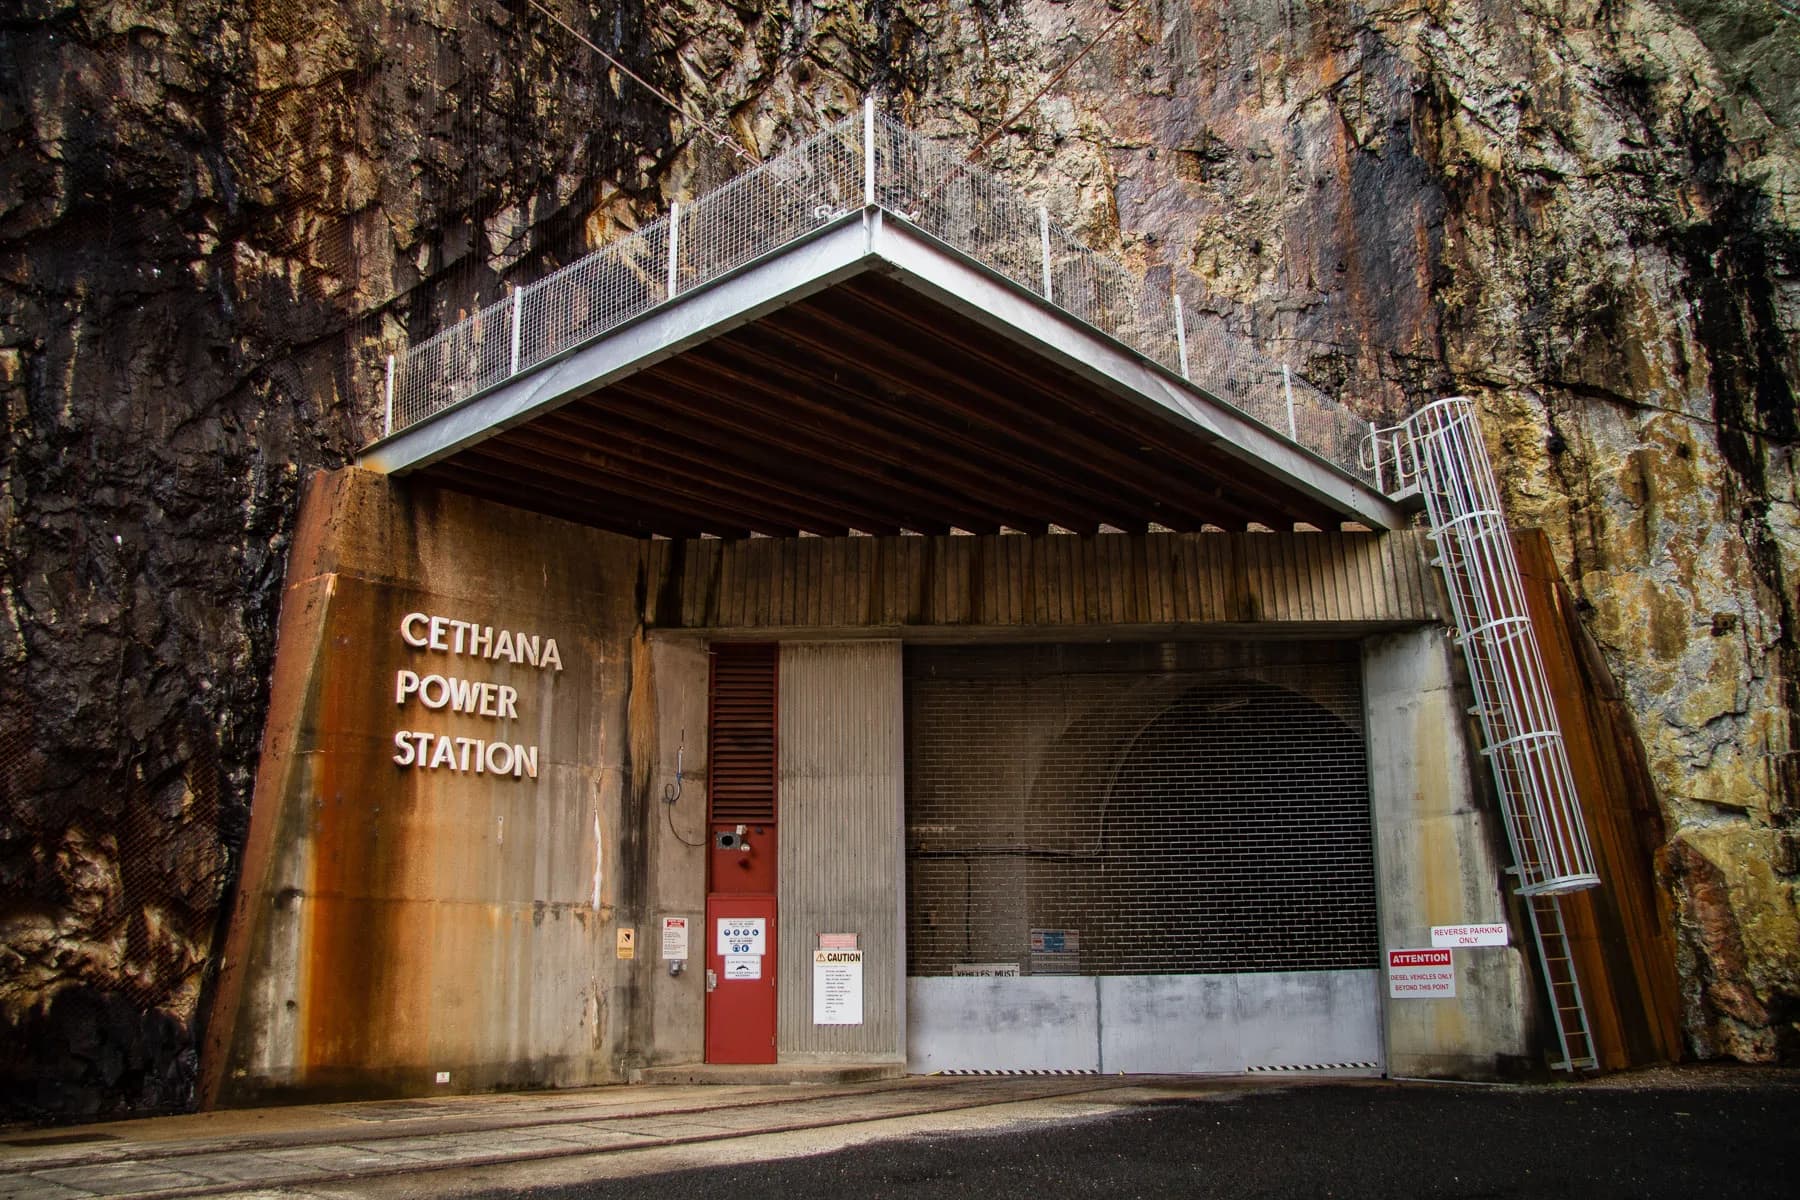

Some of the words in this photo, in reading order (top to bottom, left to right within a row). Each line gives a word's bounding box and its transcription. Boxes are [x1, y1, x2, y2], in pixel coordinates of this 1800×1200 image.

[401, 612, 563, 671] CETHANA
[396, 670, 518, 719] POWER
[393, 730, 538, 778] STATION
[1434, 928, 1468, 936] REVERSE
[1470, 926, 1503, 934] PARKING
[827, 953, 861, 962] CAUTION
[1392, 953, 1449, 963] ATTENTION
